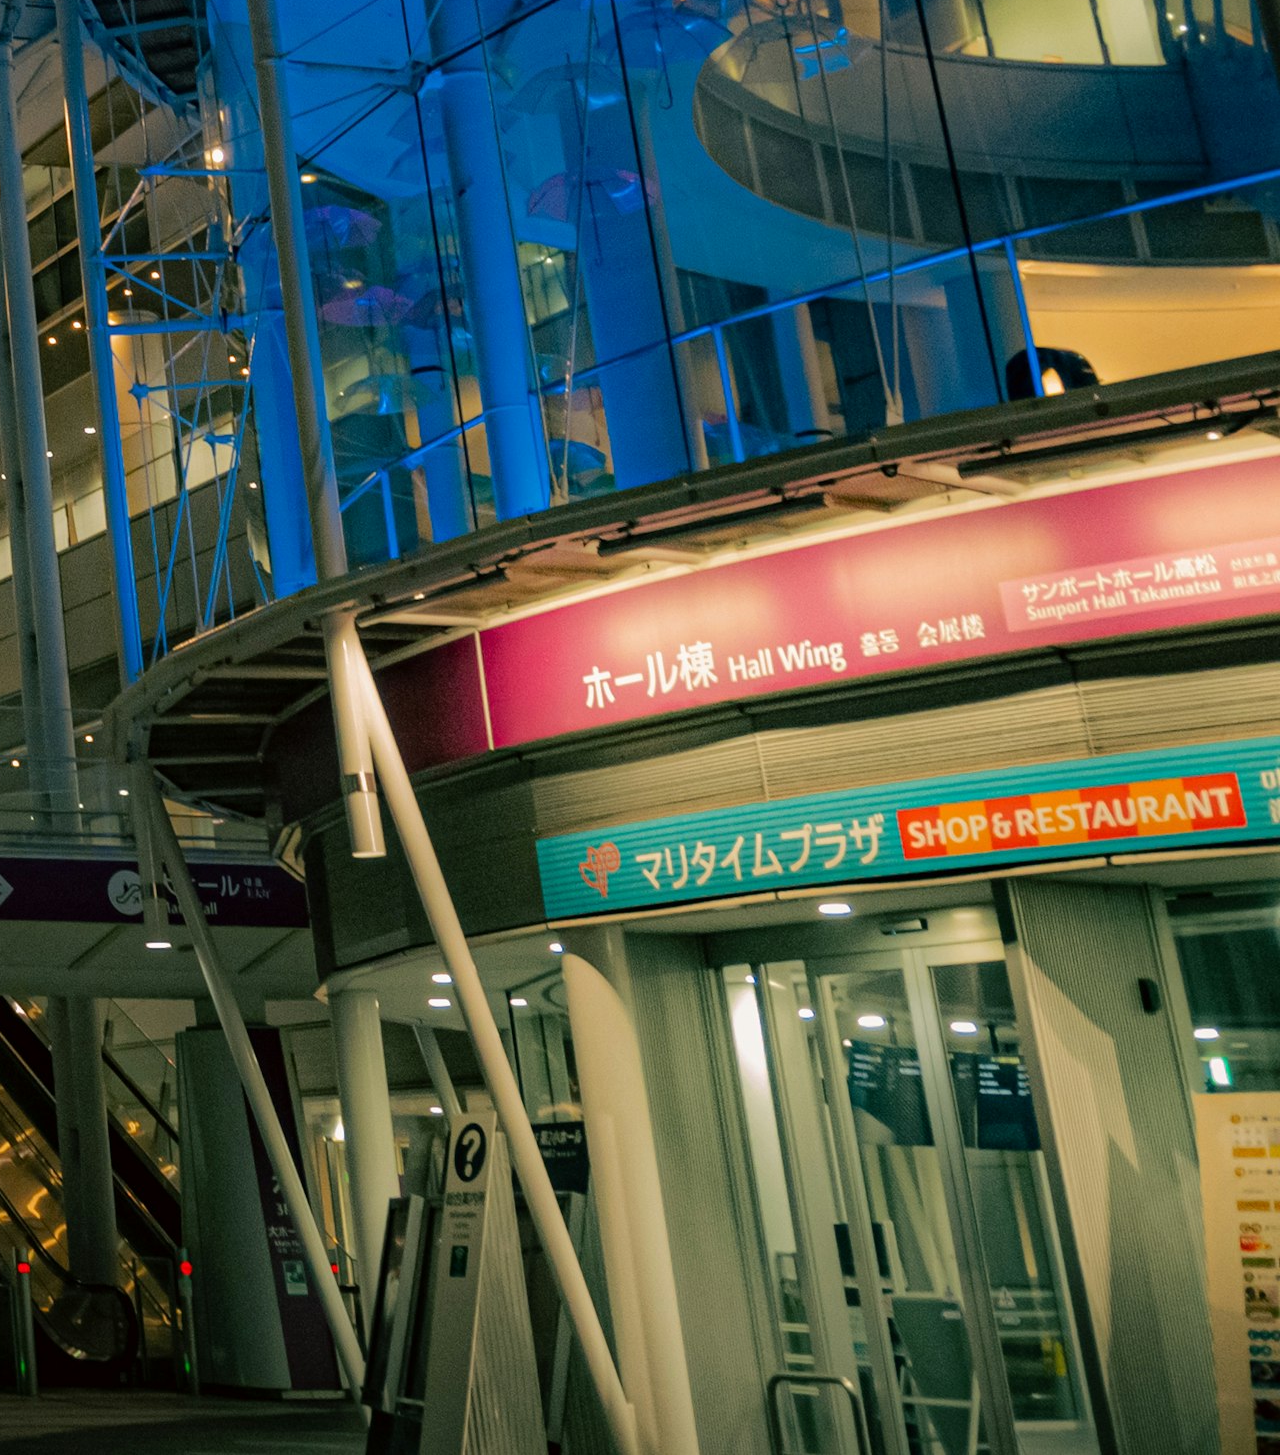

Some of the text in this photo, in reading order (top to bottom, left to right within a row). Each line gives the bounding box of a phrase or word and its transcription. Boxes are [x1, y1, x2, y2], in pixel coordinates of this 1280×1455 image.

[1026, 580, 1221, 622] Sunport Hall Takamatsu
[582, 640, 718, 709] ホール棟
[728, 640, 846, 682] Hall Wing
[637, 812, 886, 891] マリタイムプラザ
